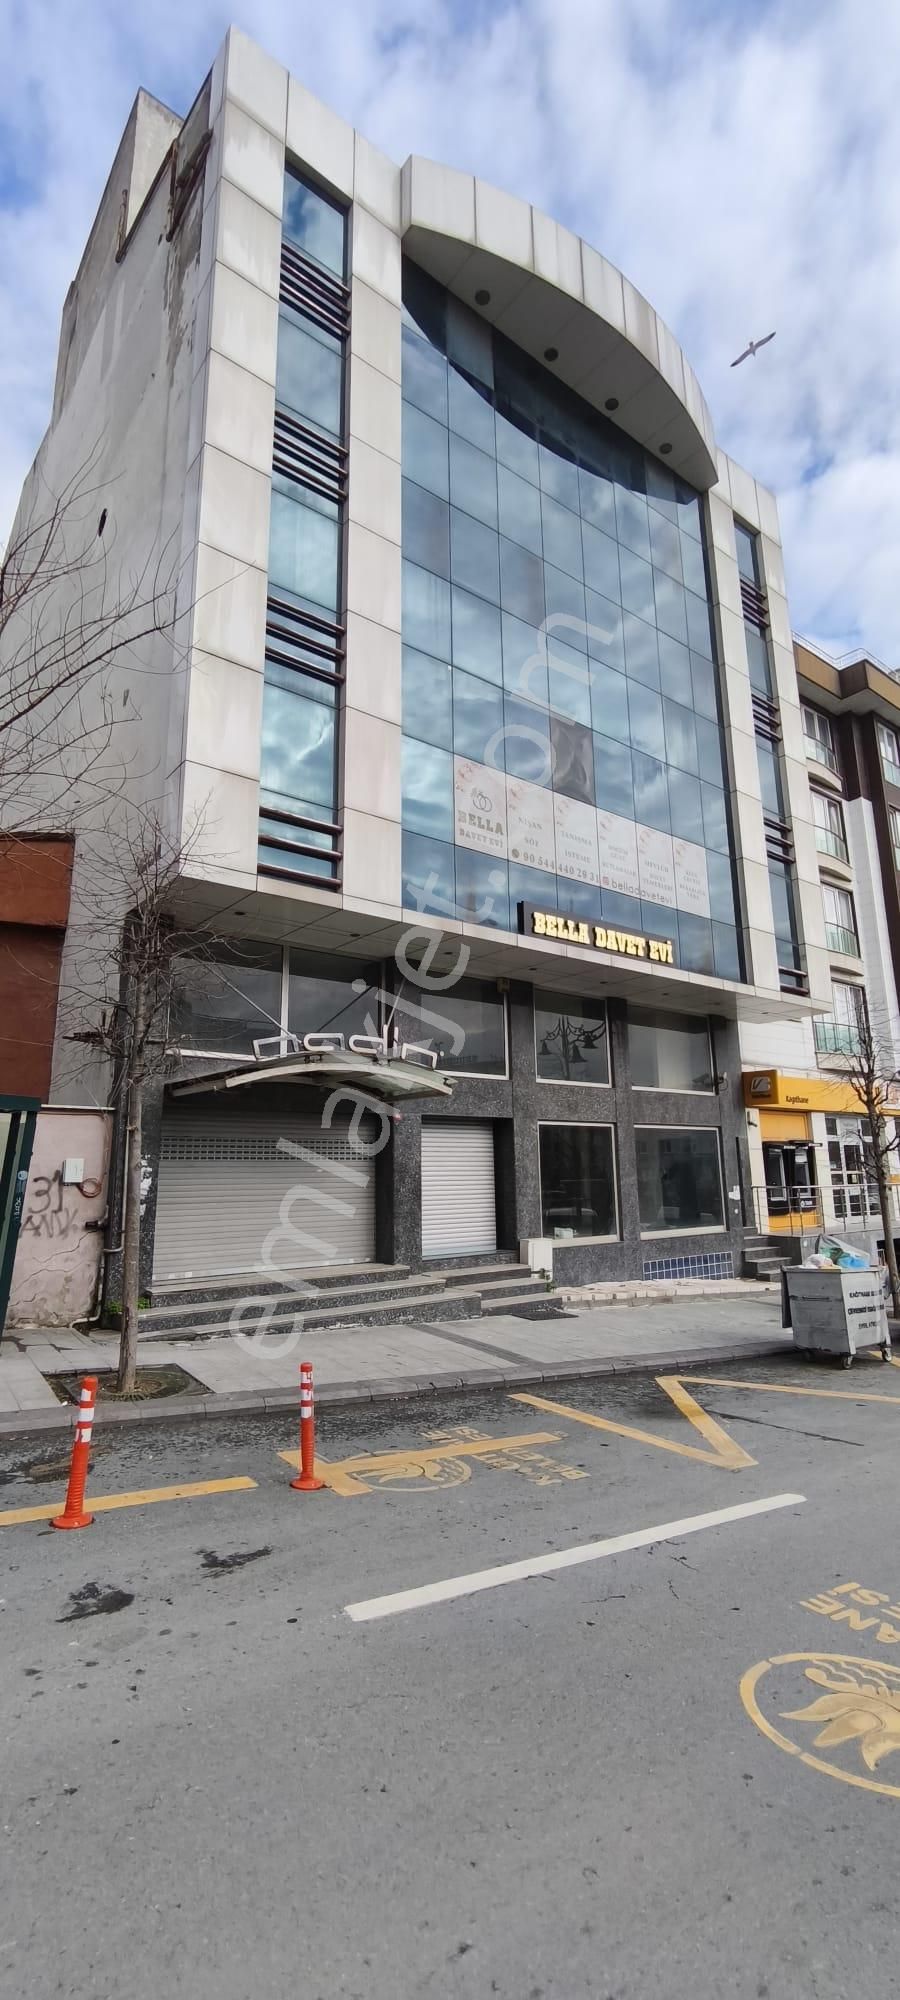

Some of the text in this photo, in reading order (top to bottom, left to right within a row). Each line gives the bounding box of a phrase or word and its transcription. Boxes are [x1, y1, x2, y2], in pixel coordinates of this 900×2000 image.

[458, 810, 504, 836] BELLA
[459, 828, 487, 843] DAVET
[532, 911, 674, 964] BELLA DAVET EVİ
